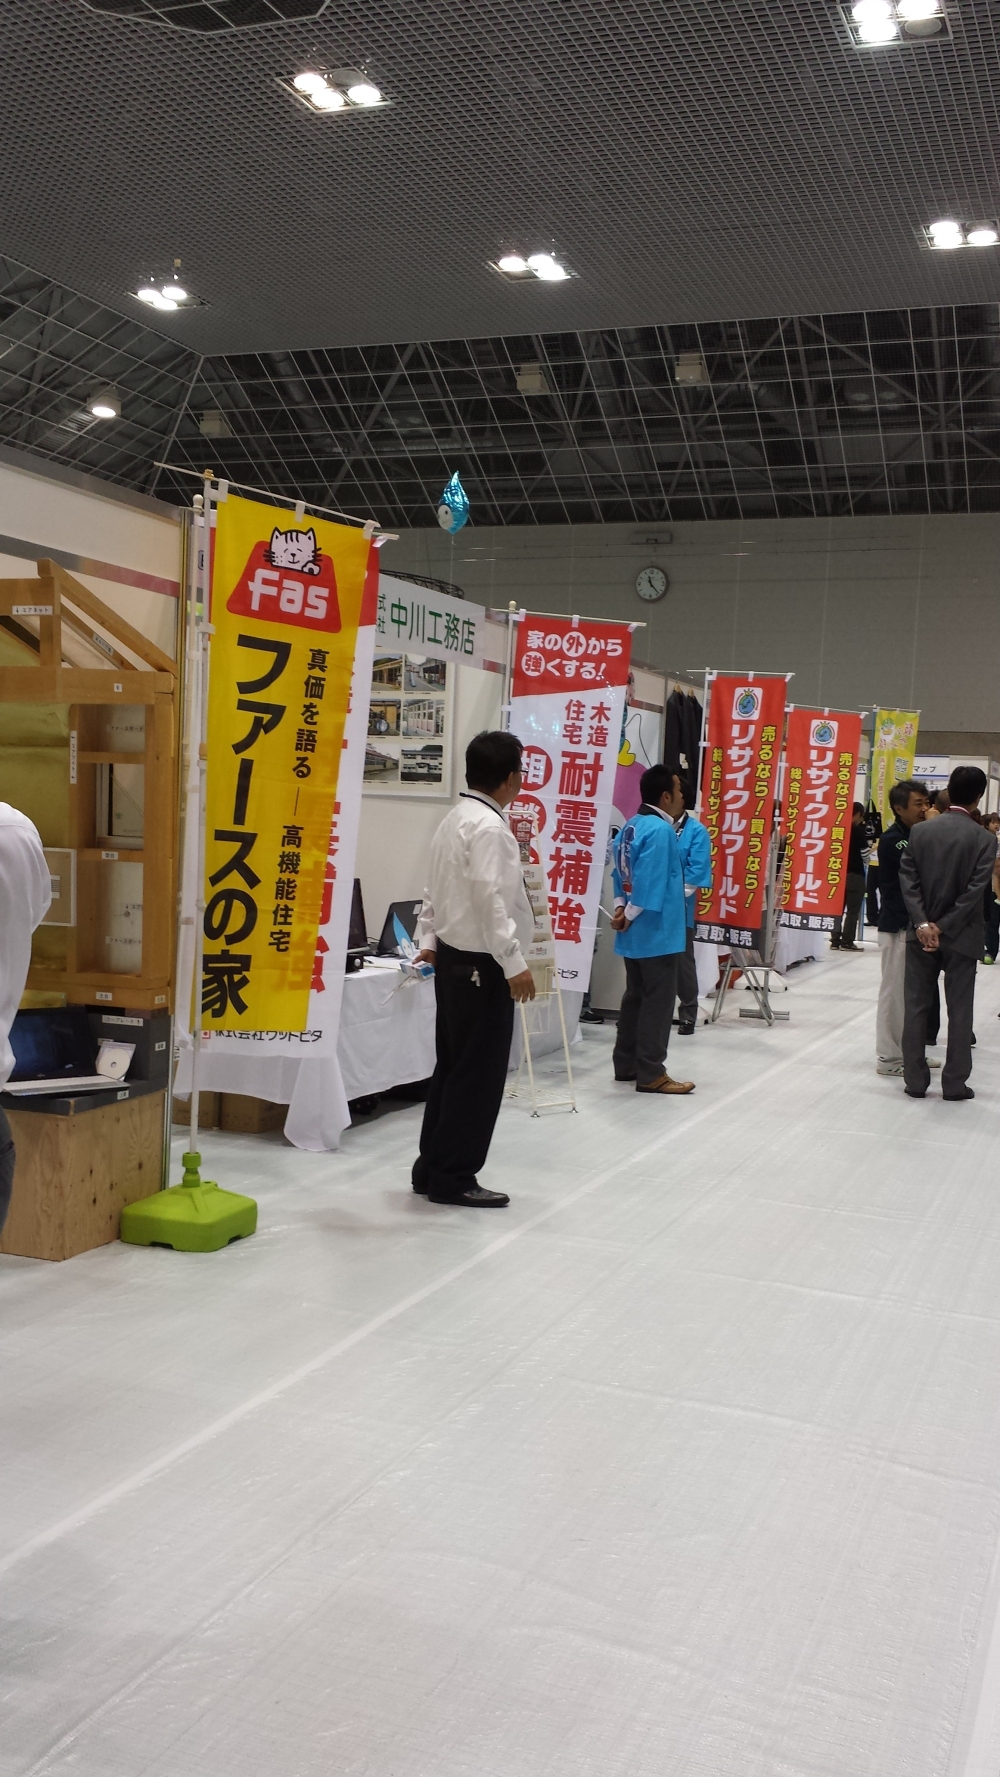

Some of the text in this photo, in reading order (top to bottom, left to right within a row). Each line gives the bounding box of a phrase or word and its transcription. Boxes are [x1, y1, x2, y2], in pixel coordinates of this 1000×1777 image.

[248, 568, 329, 619] fas
[391, 597, 476, 655] 中川工務店
[527, 630, 623, 657] 家の外から
[562, 699, 586, 746] 住宅
[587, 702, 612, 747] 木造
[202, 633, 292, 1018] ファースの家
[547, 751, 603, 944] 耐震補強
[719, 724, 756, 919] リサイクルワールド
[795, 749, 833, 908] リサイクルワールド
